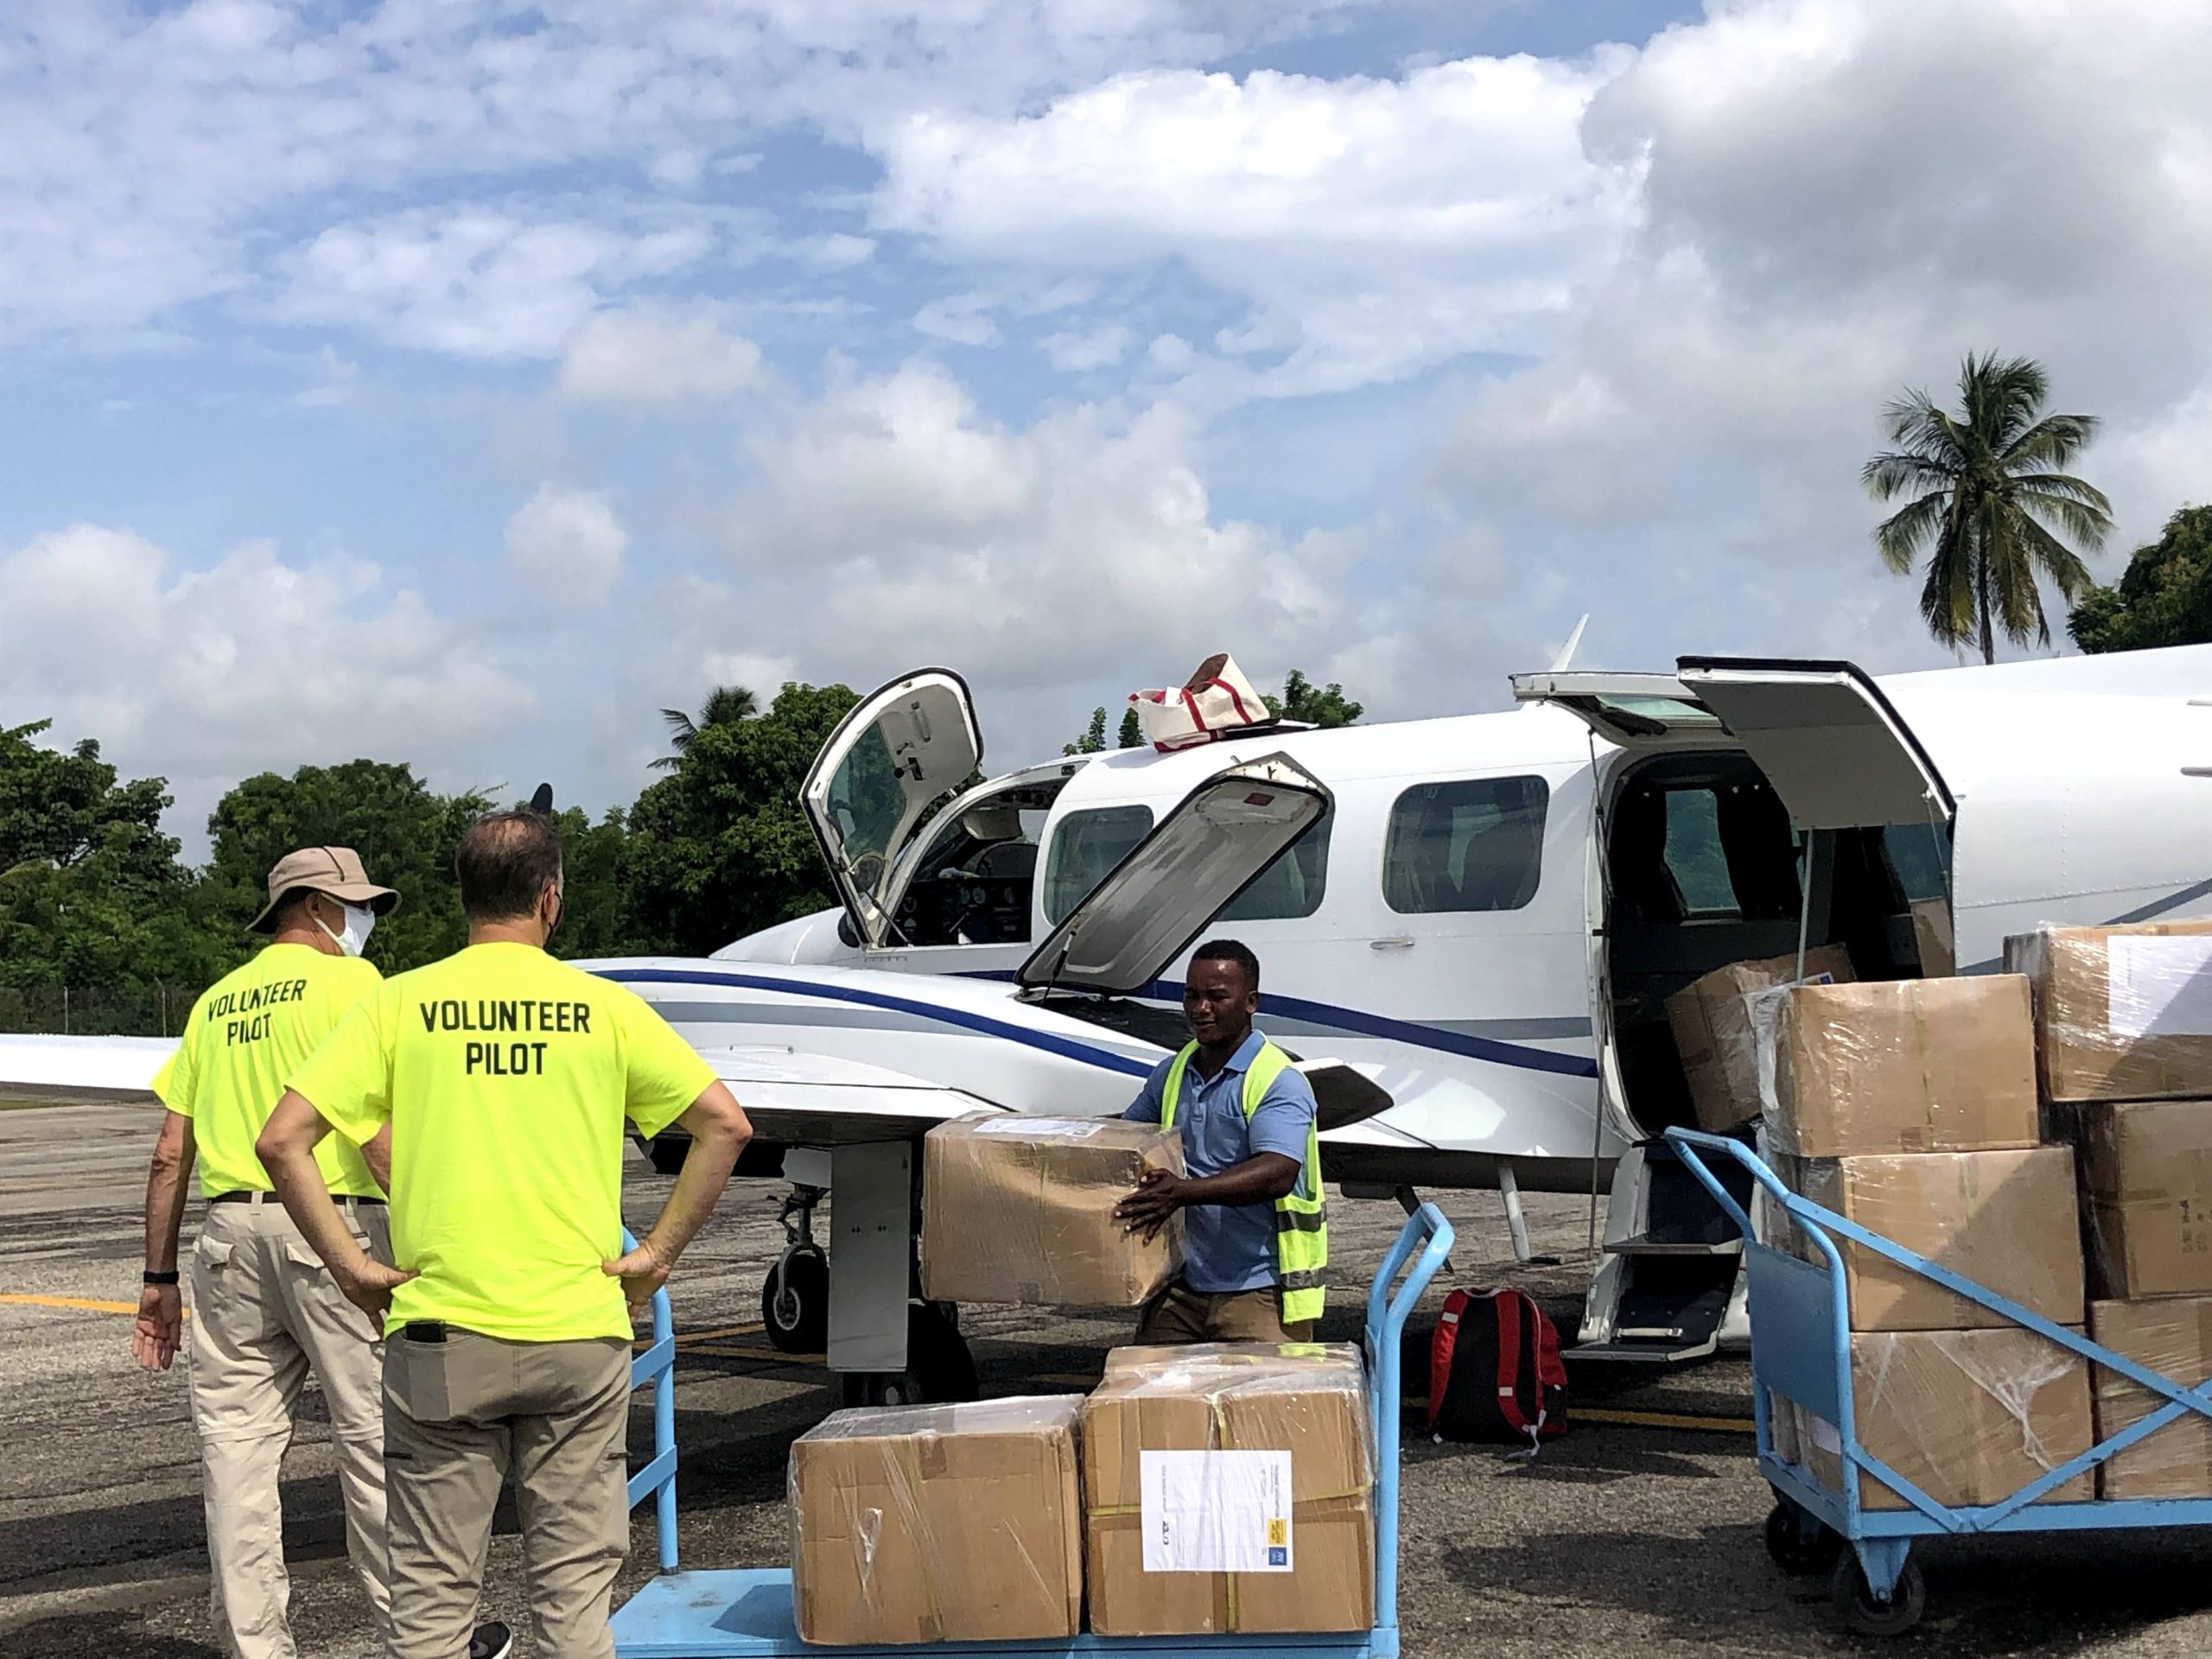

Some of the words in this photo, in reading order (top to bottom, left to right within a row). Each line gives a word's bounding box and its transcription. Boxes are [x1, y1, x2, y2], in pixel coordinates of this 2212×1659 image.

[208, 979, 307, 1022] VOLUNTEER
[420, 1000, 591, 1033] VOLUNTEER
[227, 1013, 271, 1046] PILOT
[466, 1042, 548, 1075] PILOT
